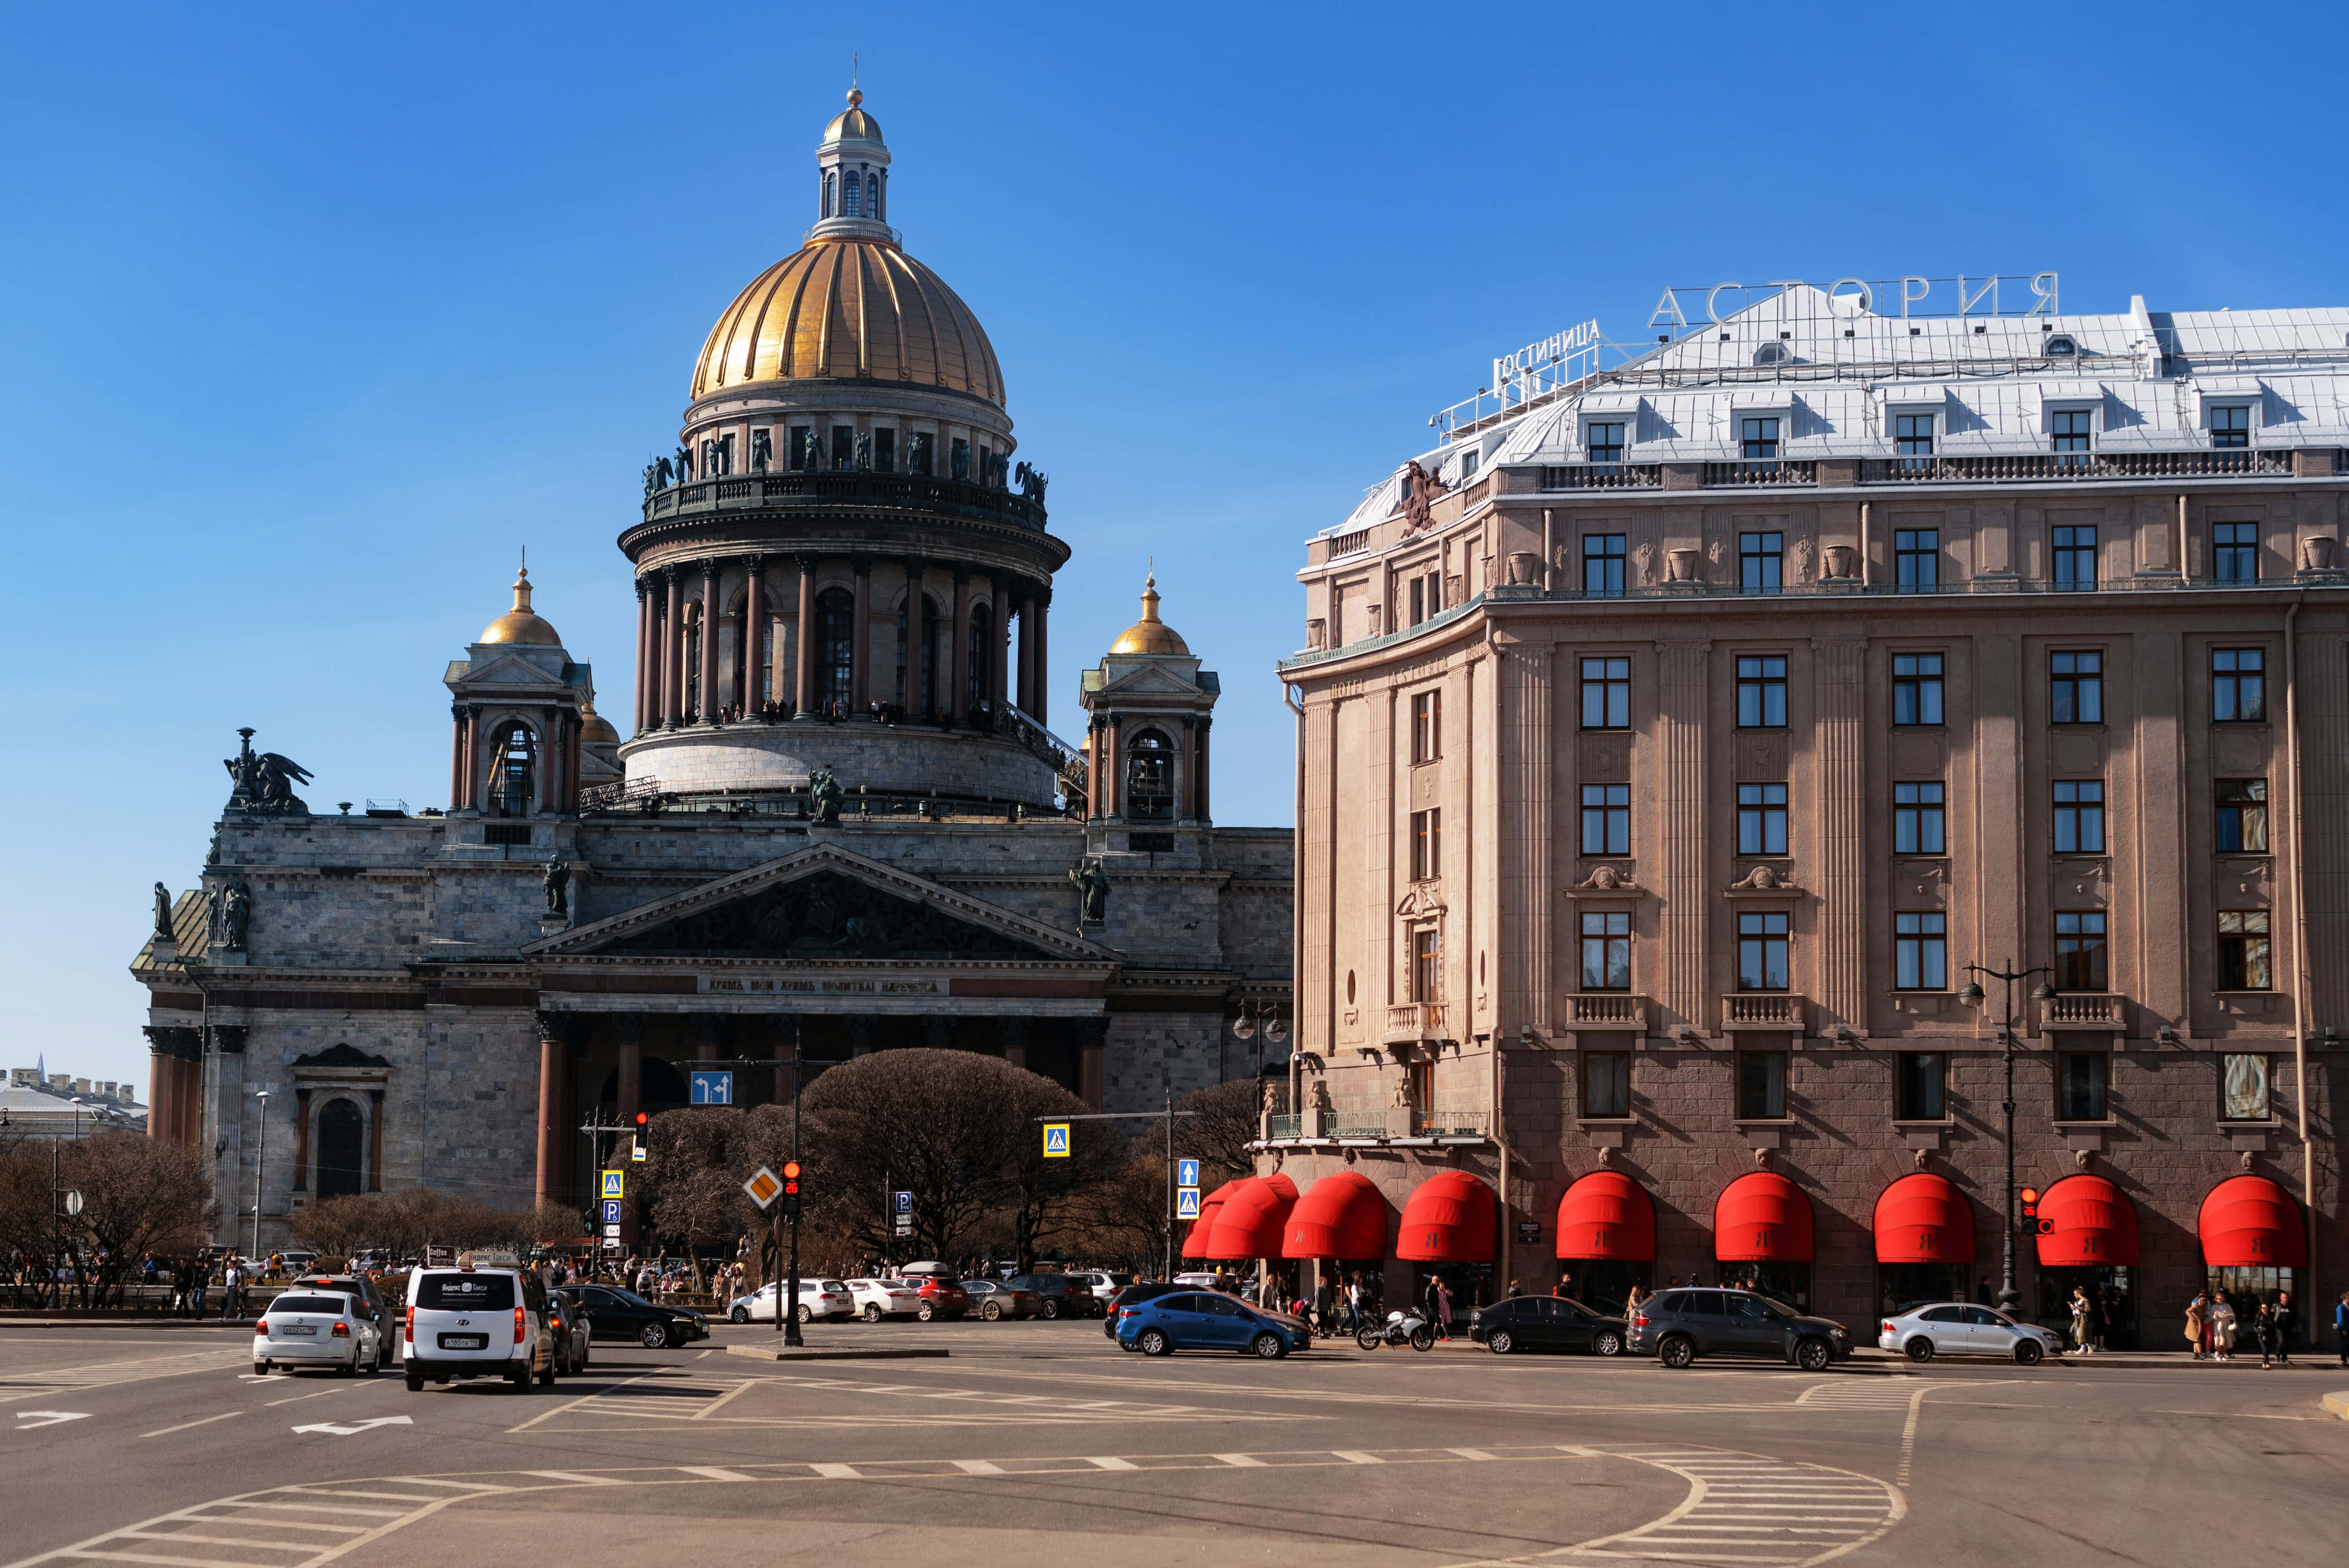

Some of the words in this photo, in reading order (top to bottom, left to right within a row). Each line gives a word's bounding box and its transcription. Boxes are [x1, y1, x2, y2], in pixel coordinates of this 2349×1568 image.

[1646, 272, 2058, 329] АСТОРИЯ
[1494, 318, 1600, 378] ГОСТИНИЦА
[786, 1182, 798, 1193] 26
[900, 1194, 908, 1210] P
[608, 1203, 617, 1220] P
[2024, 1206, 2036, 1216] 26
[430, 1248, 448, 1256] Coffee
[468, 1252, 491, 1261] Яндекс
[492, 1253, 511, 1261] Такси
